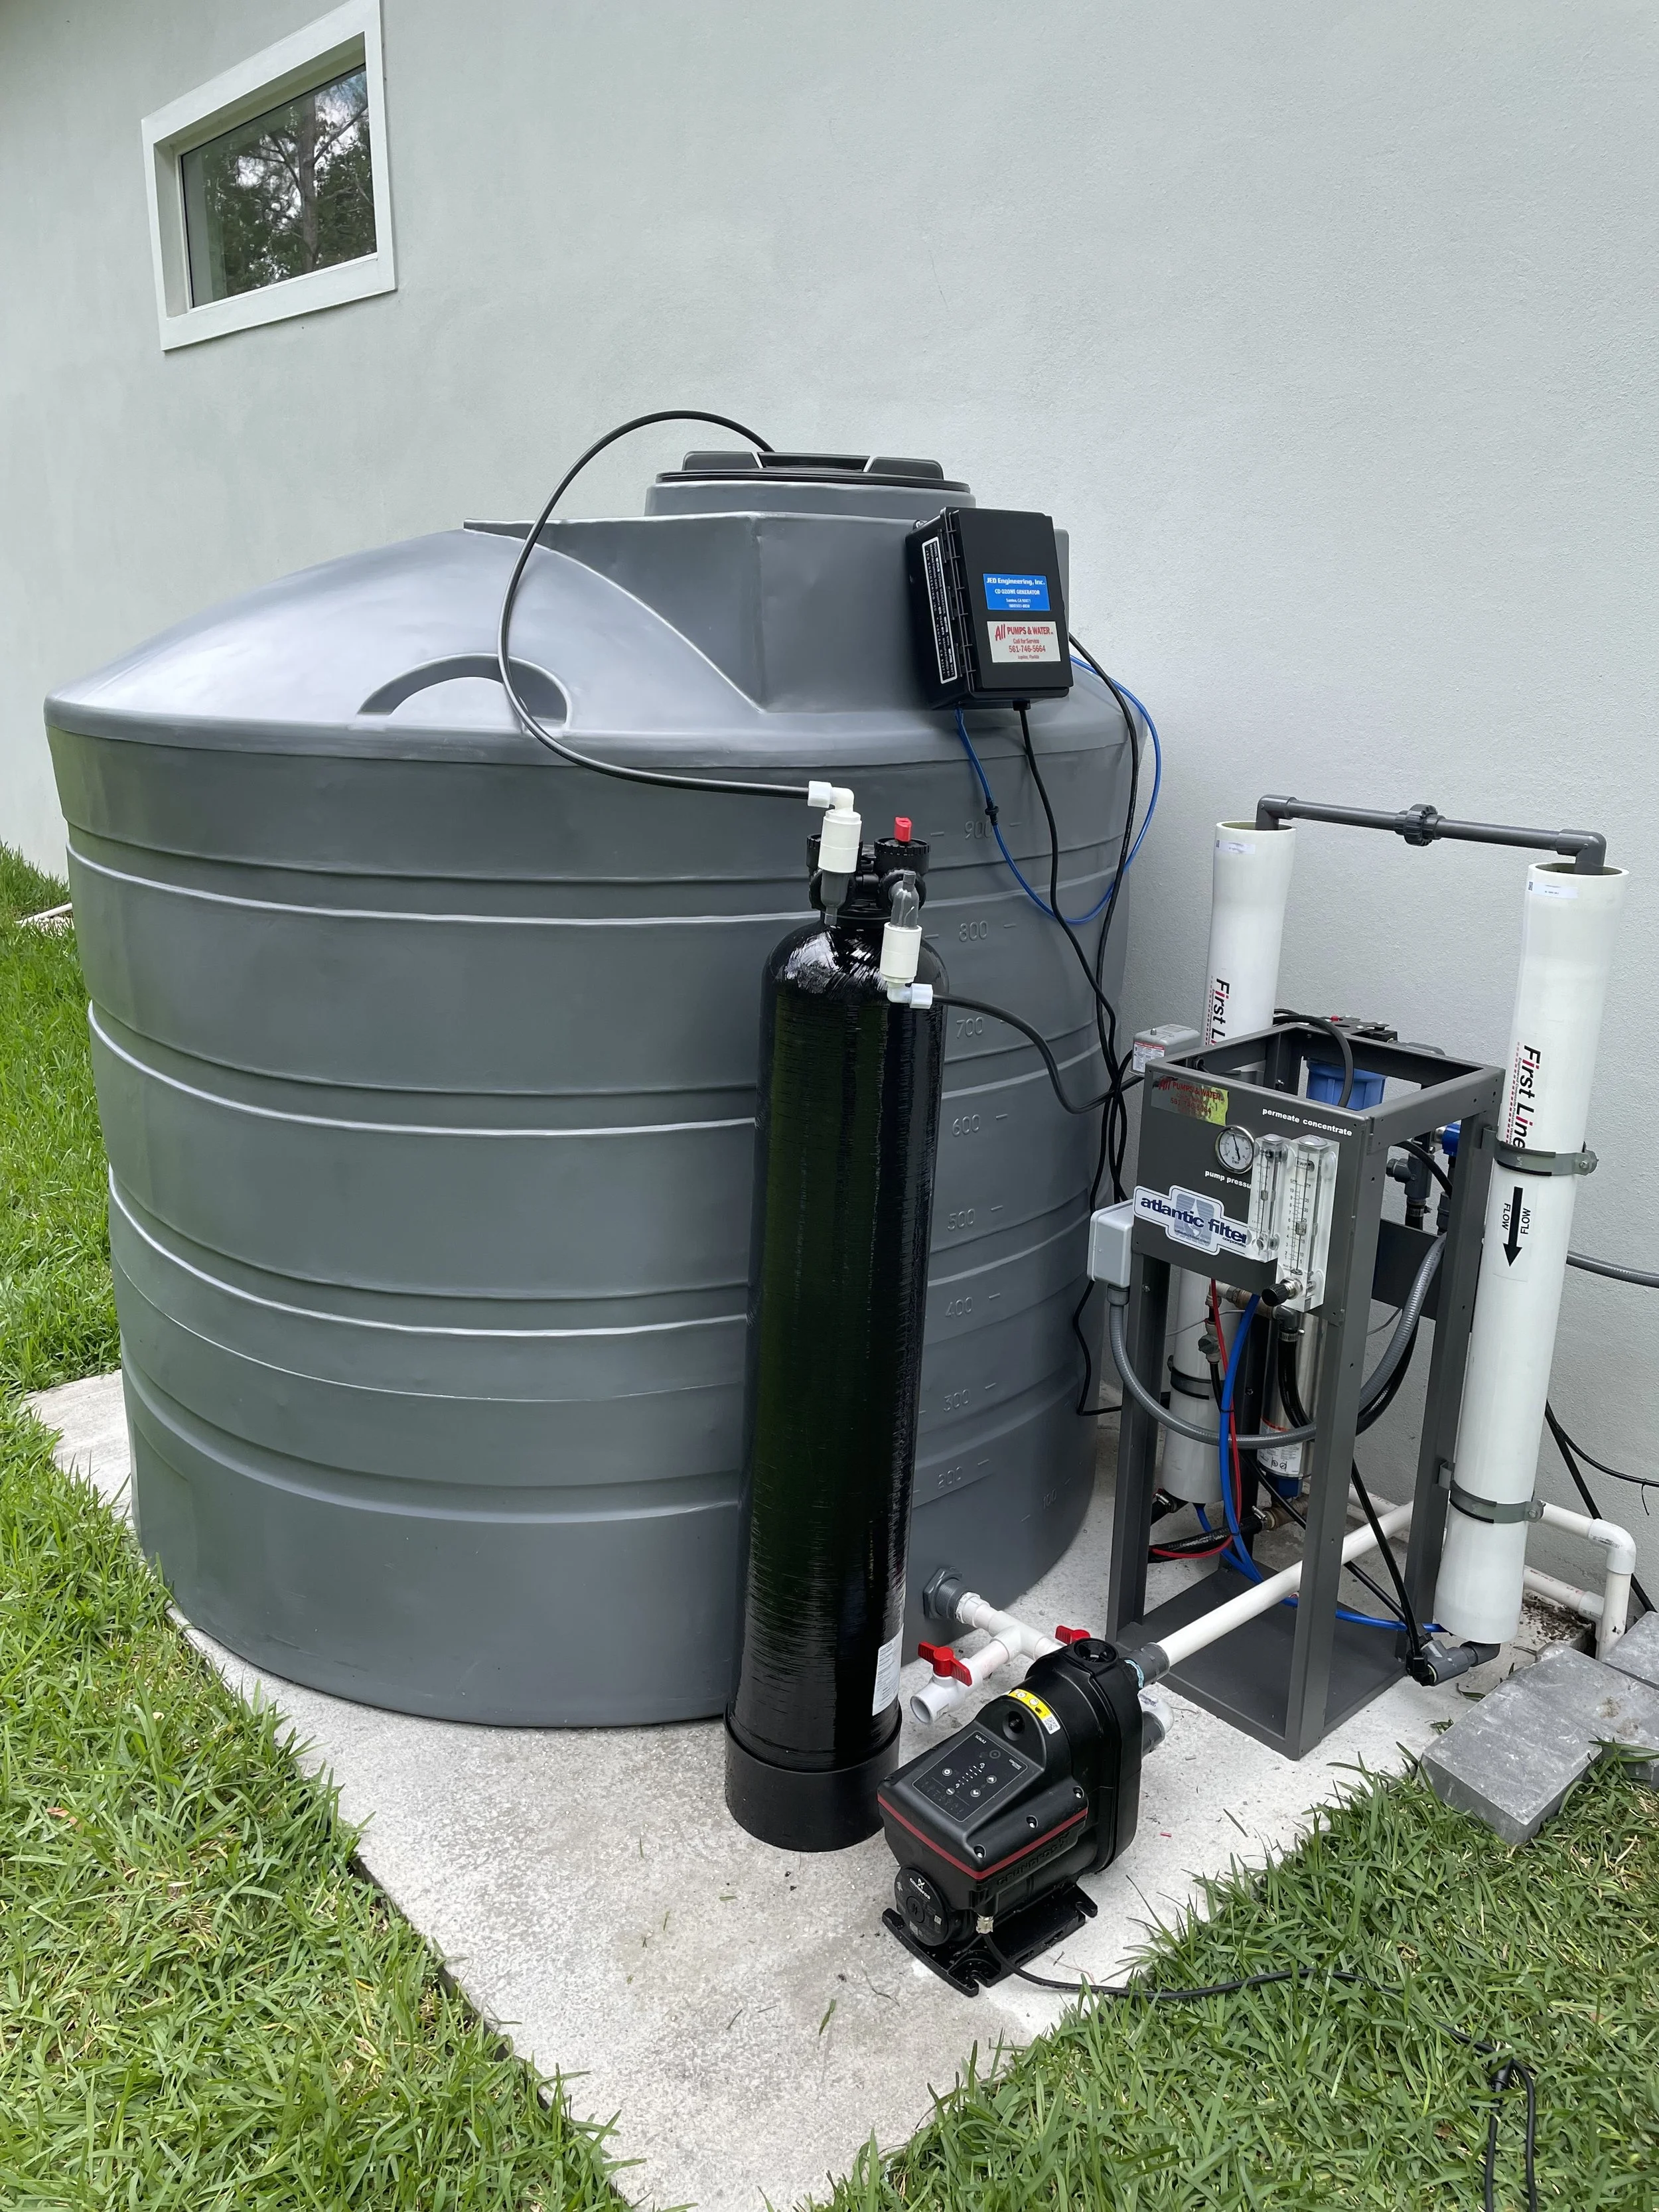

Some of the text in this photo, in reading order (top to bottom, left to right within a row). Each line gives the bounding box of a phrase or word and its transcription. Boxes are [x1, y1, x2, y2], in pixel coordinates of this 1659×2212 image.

[995, 624, 1050, 641] All PUMPS & WATER
[959, 921, 989, 942] 800
[1213, 978, 1230, 1025] First
[956, 1017, 984, 1039] 700
[1200, 1088, 1221, 1100] WATER
[1513, 1045, 1541, 1148] First Line
[952, 1114, 980, 1138] 600
[1262, 1108, 1352, 1136] permeate concentrate
[1204, 1170, 1252, 1189] pump pressu
[947, 1208, 975, 1231] 500
[1141, 1197, 1204, 1228] atlantic
[1502, 1203, 1511, 1230] FLOW
[1520, 1208, 1531, 1234] FLOW
[1222, 1236, 1246, 1248] corporatio
[945, 1296, 973, 1319] 400
[944, 1389, 970, 1412] 300
[938, 1466, 963, 1489] 200
